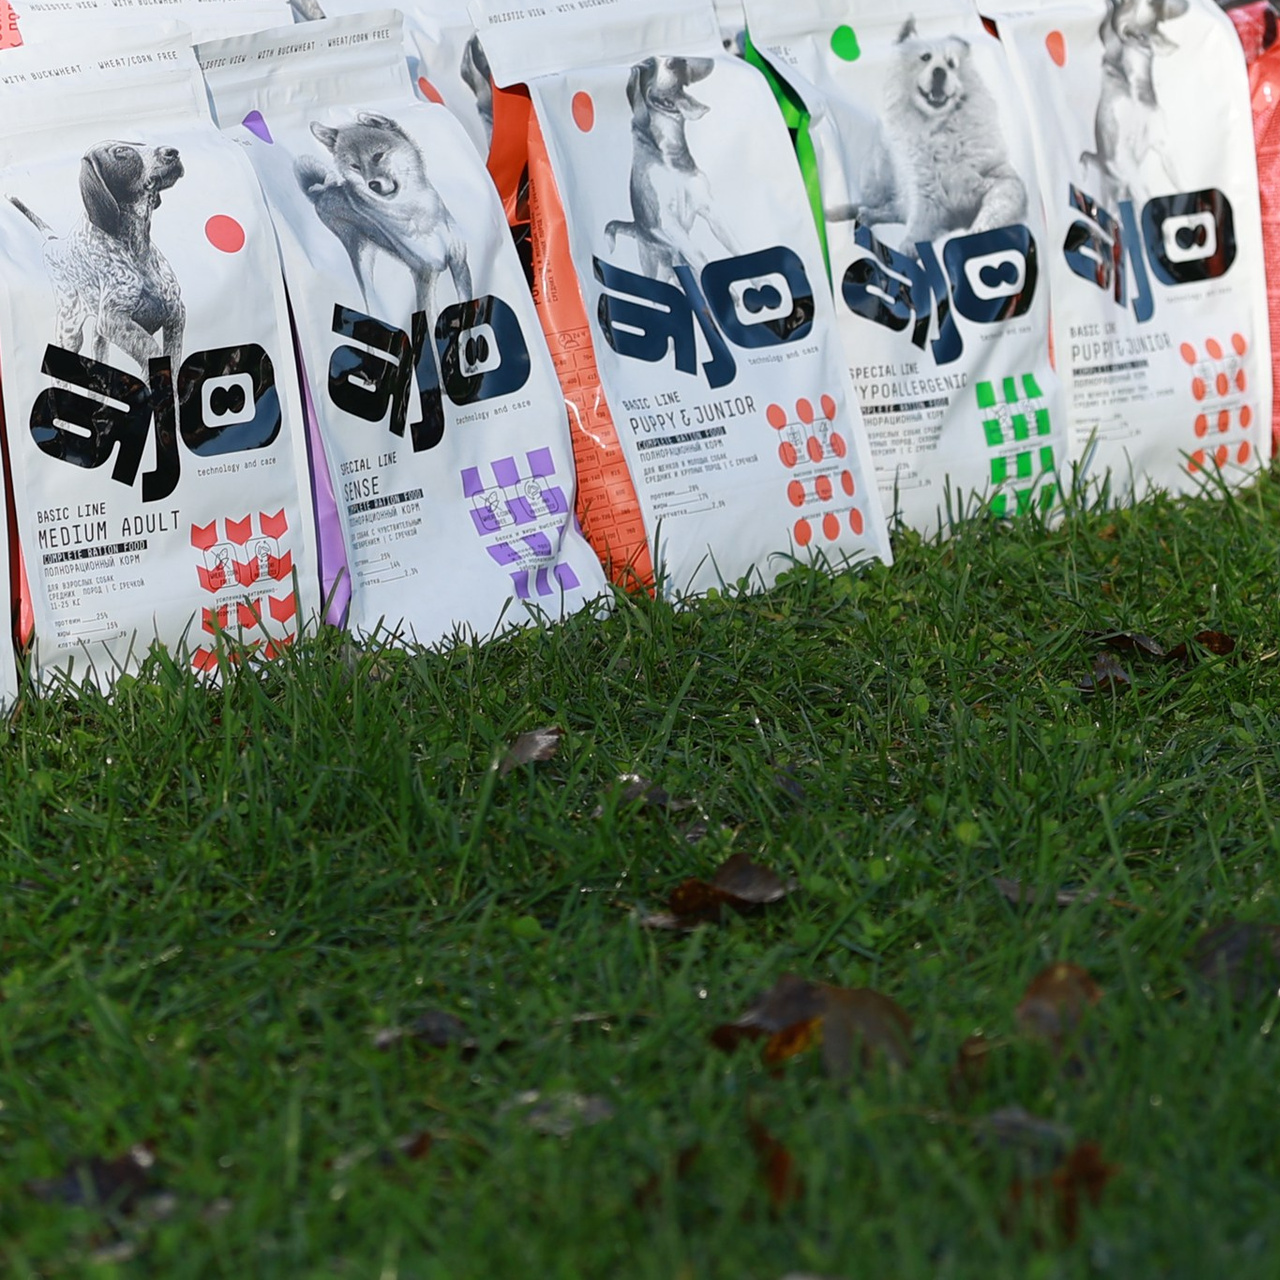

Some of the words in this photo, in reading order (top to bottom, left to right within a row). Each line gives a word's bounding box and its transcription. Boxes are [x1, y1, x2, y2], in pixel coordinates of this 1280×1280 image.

[29, 0, 72, 11] HOLISTIC
[76, 0, 98, 9] VIEW
[489, 10, 523, 24] HOLISTIC
[527, 6, 546, 18] VIEW
[557, 2, 575, 14] WITH
[228, 54, 246, 66] VIEW
[257, 49, 275, 60] WITH
[277, 43, 316, 58] BUCKWHEAT
[327, 31, 370, 47] WHEAT/CORN
[372, 28, 391, 40] FREE
[1, 73, 28, 85] WITH
[30, 64, 82, 80] BUCKWHEAT
[97, 56, 154, 70] WHEAT/CORN
[157, 49, 179, 62] FREE
[849, 363, 897, 380] SPECIAL
[455, 411, 491, 426] technology
[493, 404, 509, 417] and
[512, 399, 532, 411] care
[622, 397, 651, 411] BASIC
[654, 391, 682, 407] LINE
[629, 411, 677, 435] PUPPY
[693, 395, 757, 424] JUNIOR
[196, 462, 241, 477] technology
[244, 459, 258, 470] and
[260, 455, 277, 467] care
[340, 457, 372, 476] SPECIAL
[378, 451, 398, 468] LINE
[344, 475, 380, 503] SENSE
[36, 506, 70, 524] BASIC
[77, 502, 106, 518] LINE
[401, 502, 421, 515] КОРМ
[38, 520, 107, 550] MEDIUM
[122, 510, 180, 537] ADULT
[43, 549, 85, 564] COMPLETE
[88, 544, 119, 558] RATION
[124, 540, 145, 552] FOOD
[44, 556, 115, 578] ПОЛНОРАЦИОННЫЙ
[119, 554, 141, 566] КОРМ
[48, 590, 76, 601] СРЕДНИХ
[82, 586, 102, 596] ПОРОД
[62, 578, 93, 590] ВЗРОСЛЫХ
[95, 575, 114, 585] СОБАК
